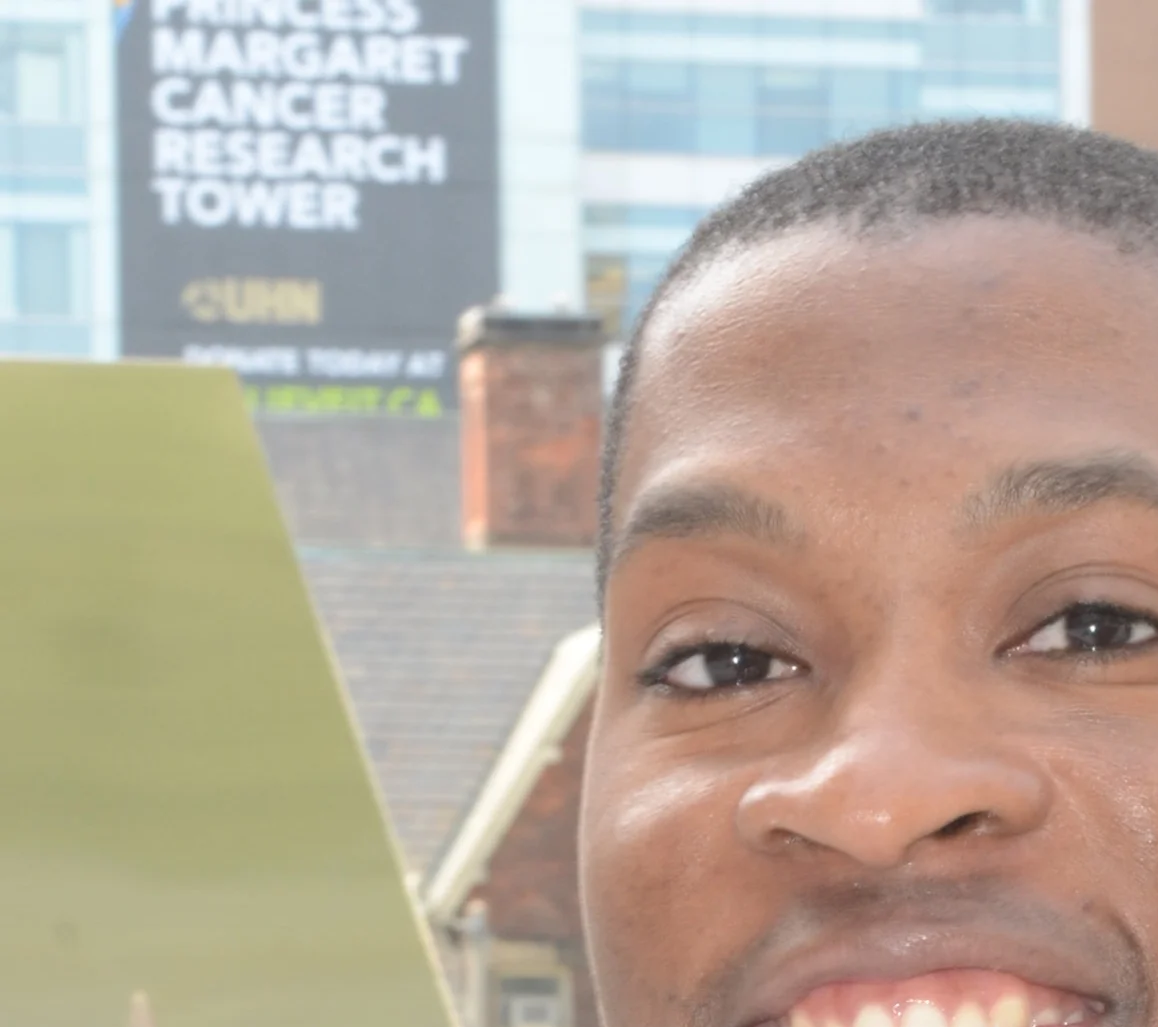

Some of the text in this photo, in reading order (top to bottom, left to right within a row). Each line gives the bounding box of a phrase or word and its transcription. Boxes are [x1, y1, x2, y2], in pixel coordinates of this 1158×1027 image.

[151, 28, 469, 84] MARGARET
[151, 77, 388, 132] CANCER
[153, 128, 447, 183] RESEARCH
[152, 178, 361, 229] TOWER
